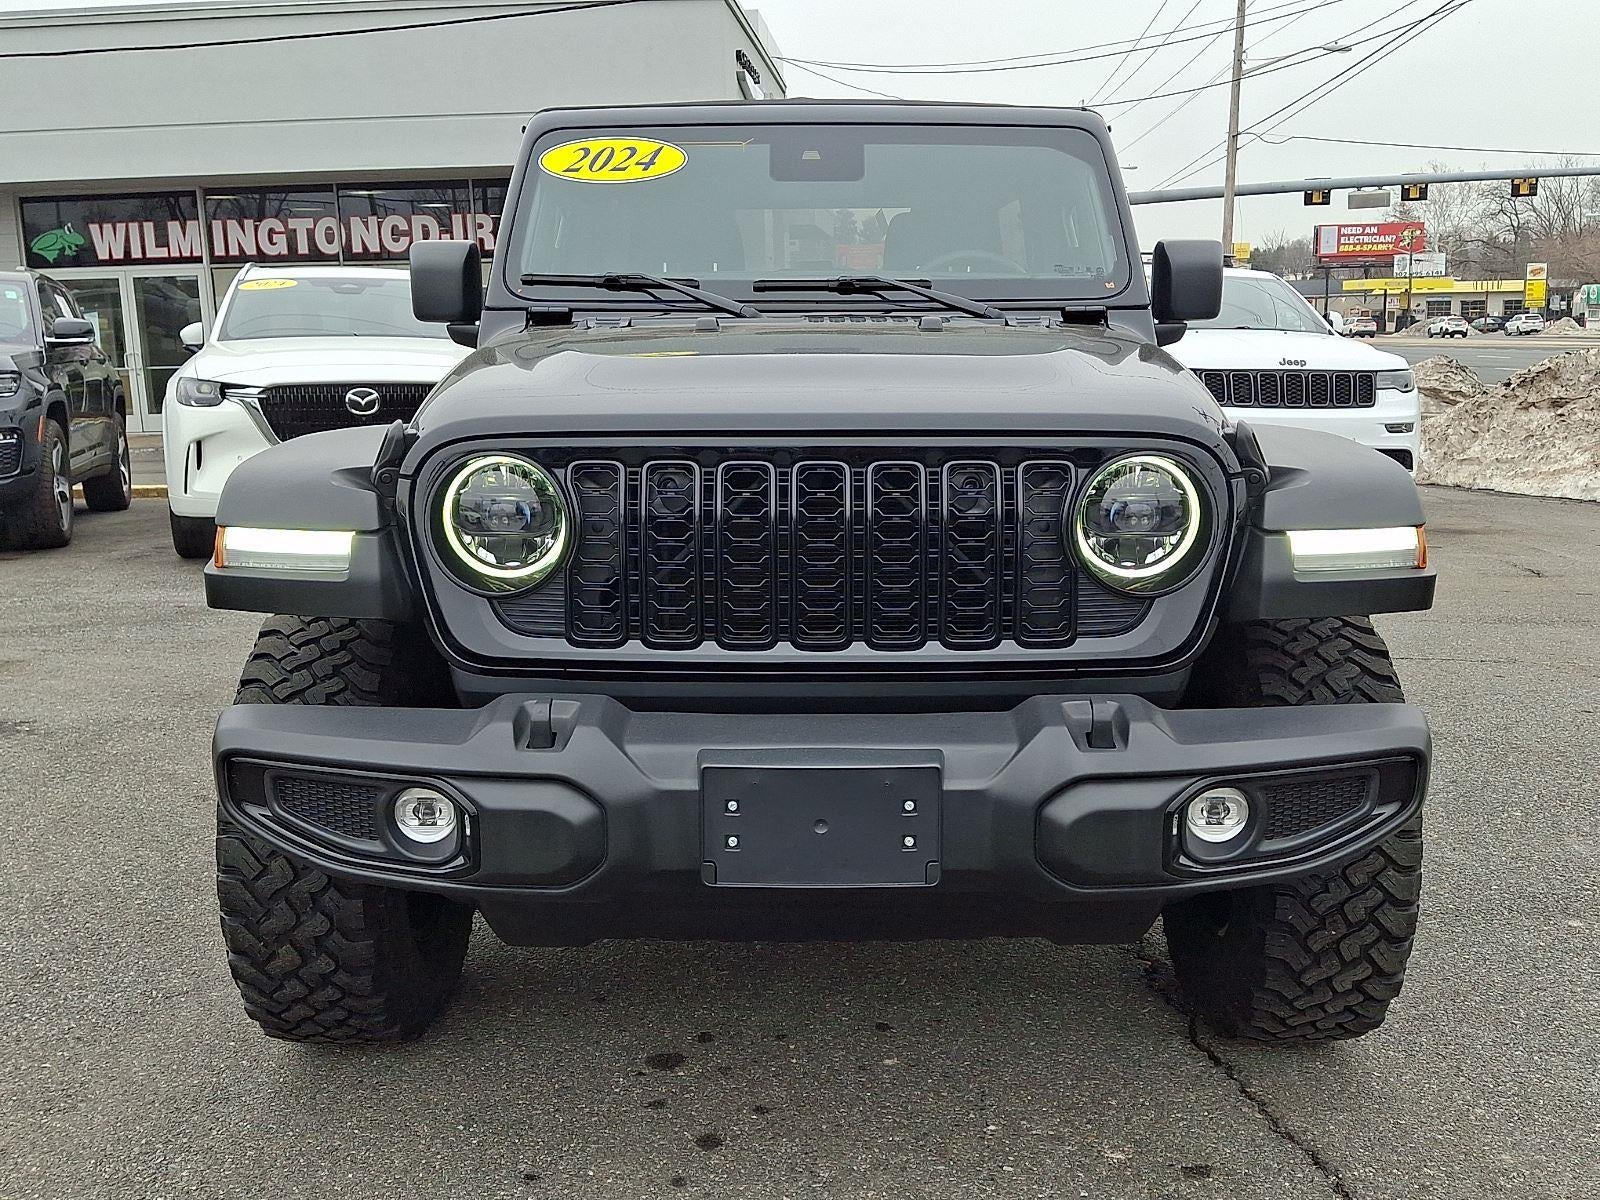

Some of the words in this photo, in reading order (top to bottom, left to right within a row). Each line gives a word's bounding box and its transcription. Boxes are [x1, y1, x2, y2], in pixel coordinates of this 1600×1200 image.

[562, 146, 664, 172] 2024
[1341, 226, 1363, 235] NEED
[1365, 226, 1378, 234] AN
[1340, 235, 1396, 244] ELECTRICIAN?
[1278, 357, 1307, 368] Jeep
